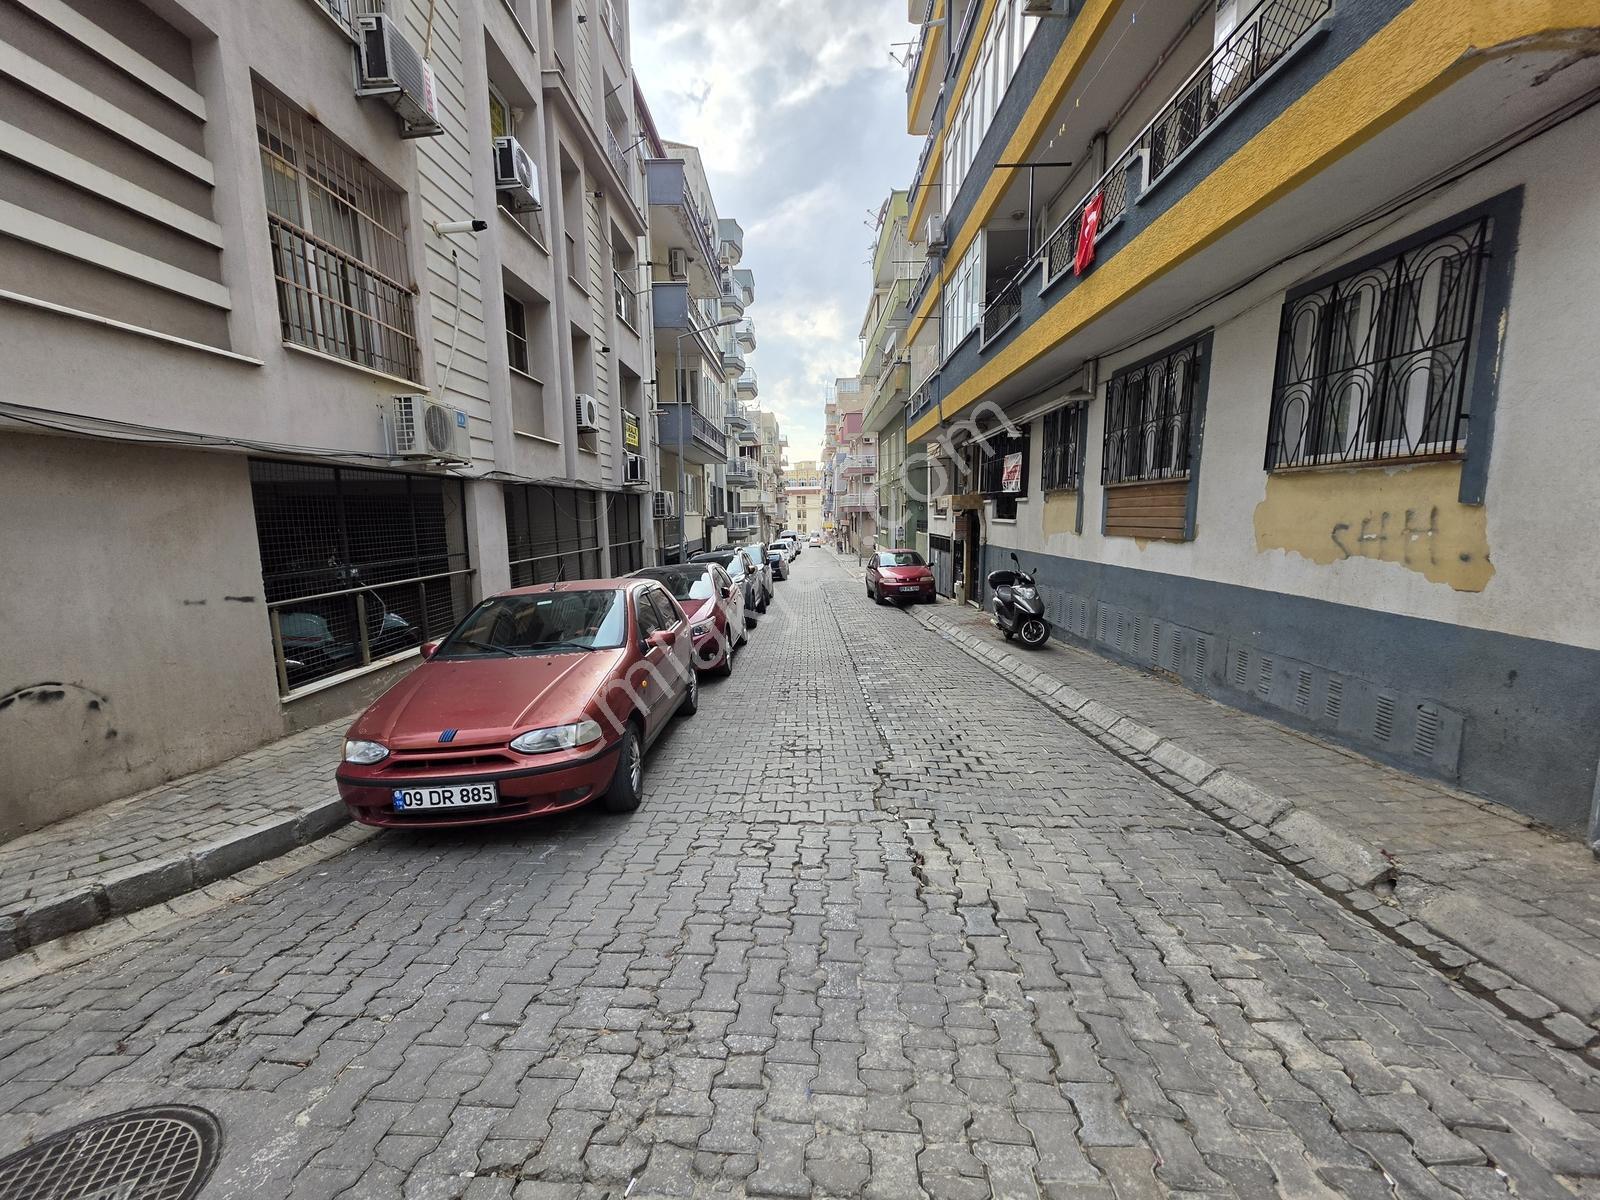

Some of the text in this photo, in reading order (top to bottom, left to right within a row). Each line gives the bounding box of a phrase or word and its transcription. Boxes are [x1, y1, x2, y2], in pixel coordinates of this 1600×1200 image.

[403, 791, 423, 807] 09
[429, 789, 454, 806] DR
[460, 786, 492, 803] 885
